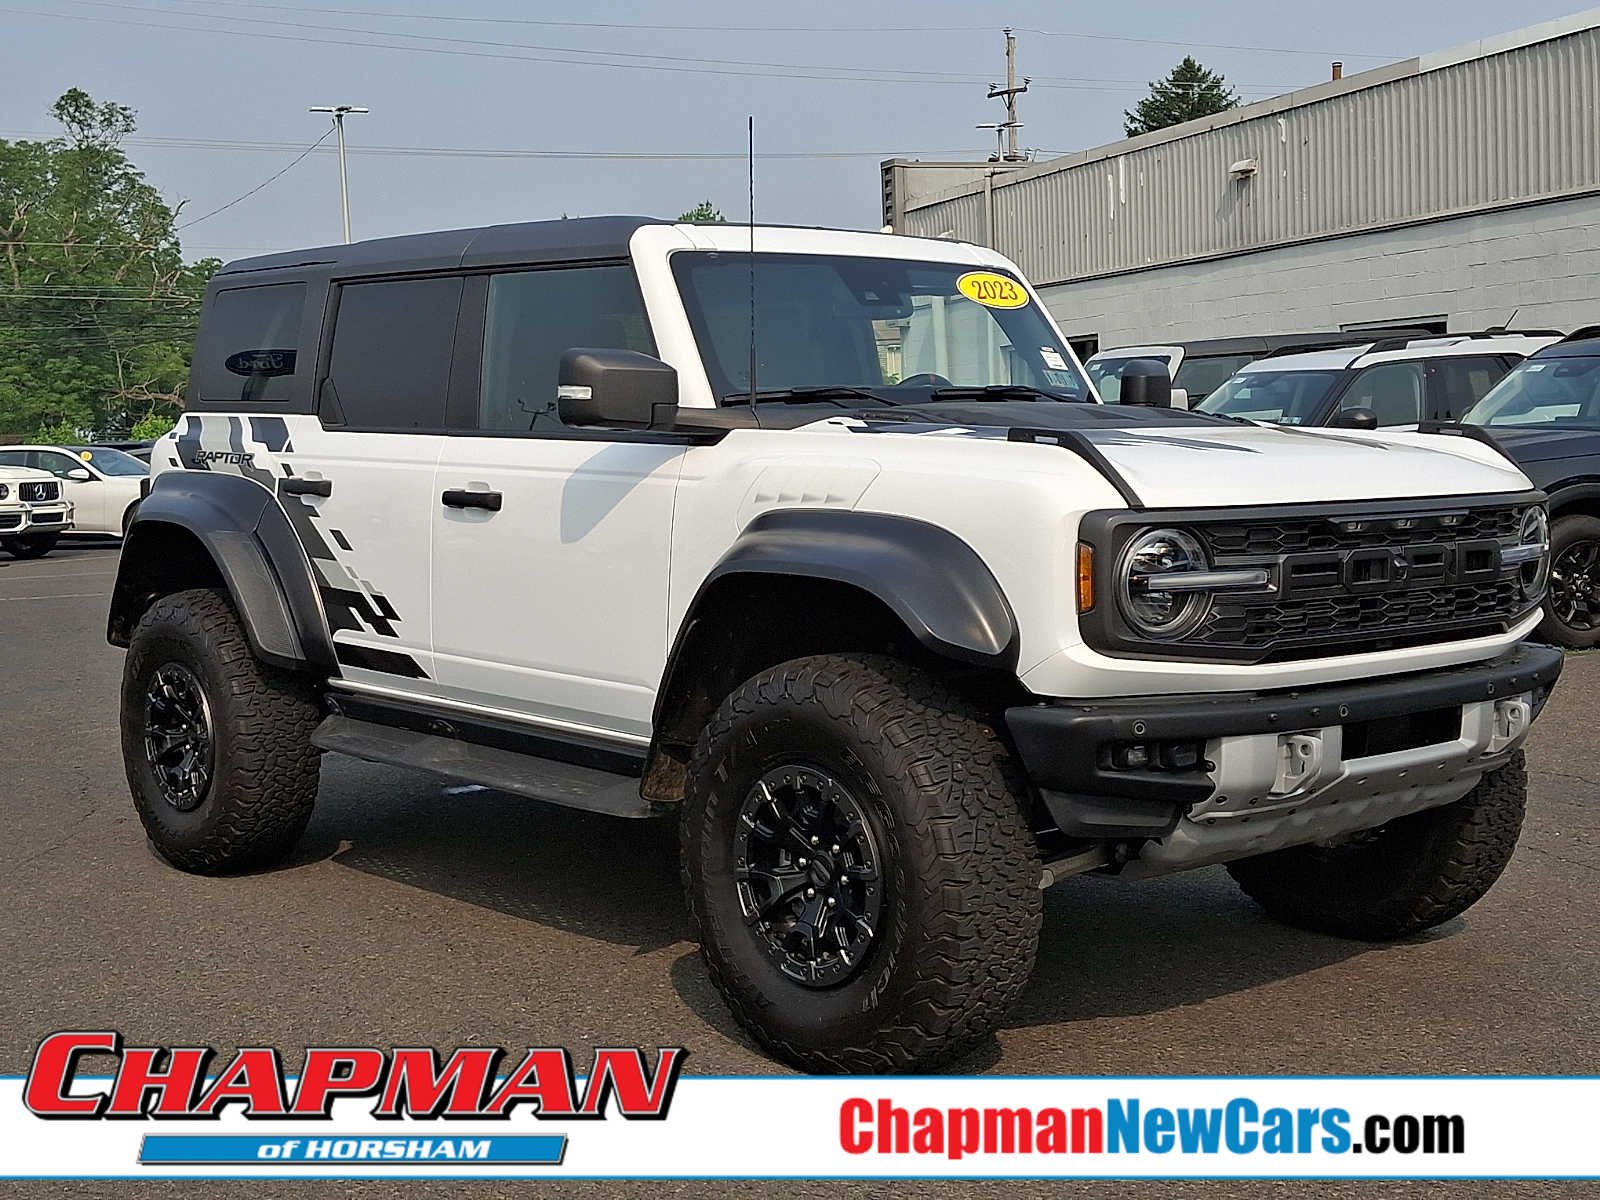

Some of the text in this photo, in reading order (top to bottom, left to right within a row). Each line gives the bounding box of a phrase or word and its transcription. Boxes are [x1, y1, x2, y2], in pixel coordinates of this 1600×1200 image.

[971, 280, 1018, 301] 2023
[195, 449, 256, 472] RAPTOR
[1280, 538, 1503, 601] FORD
